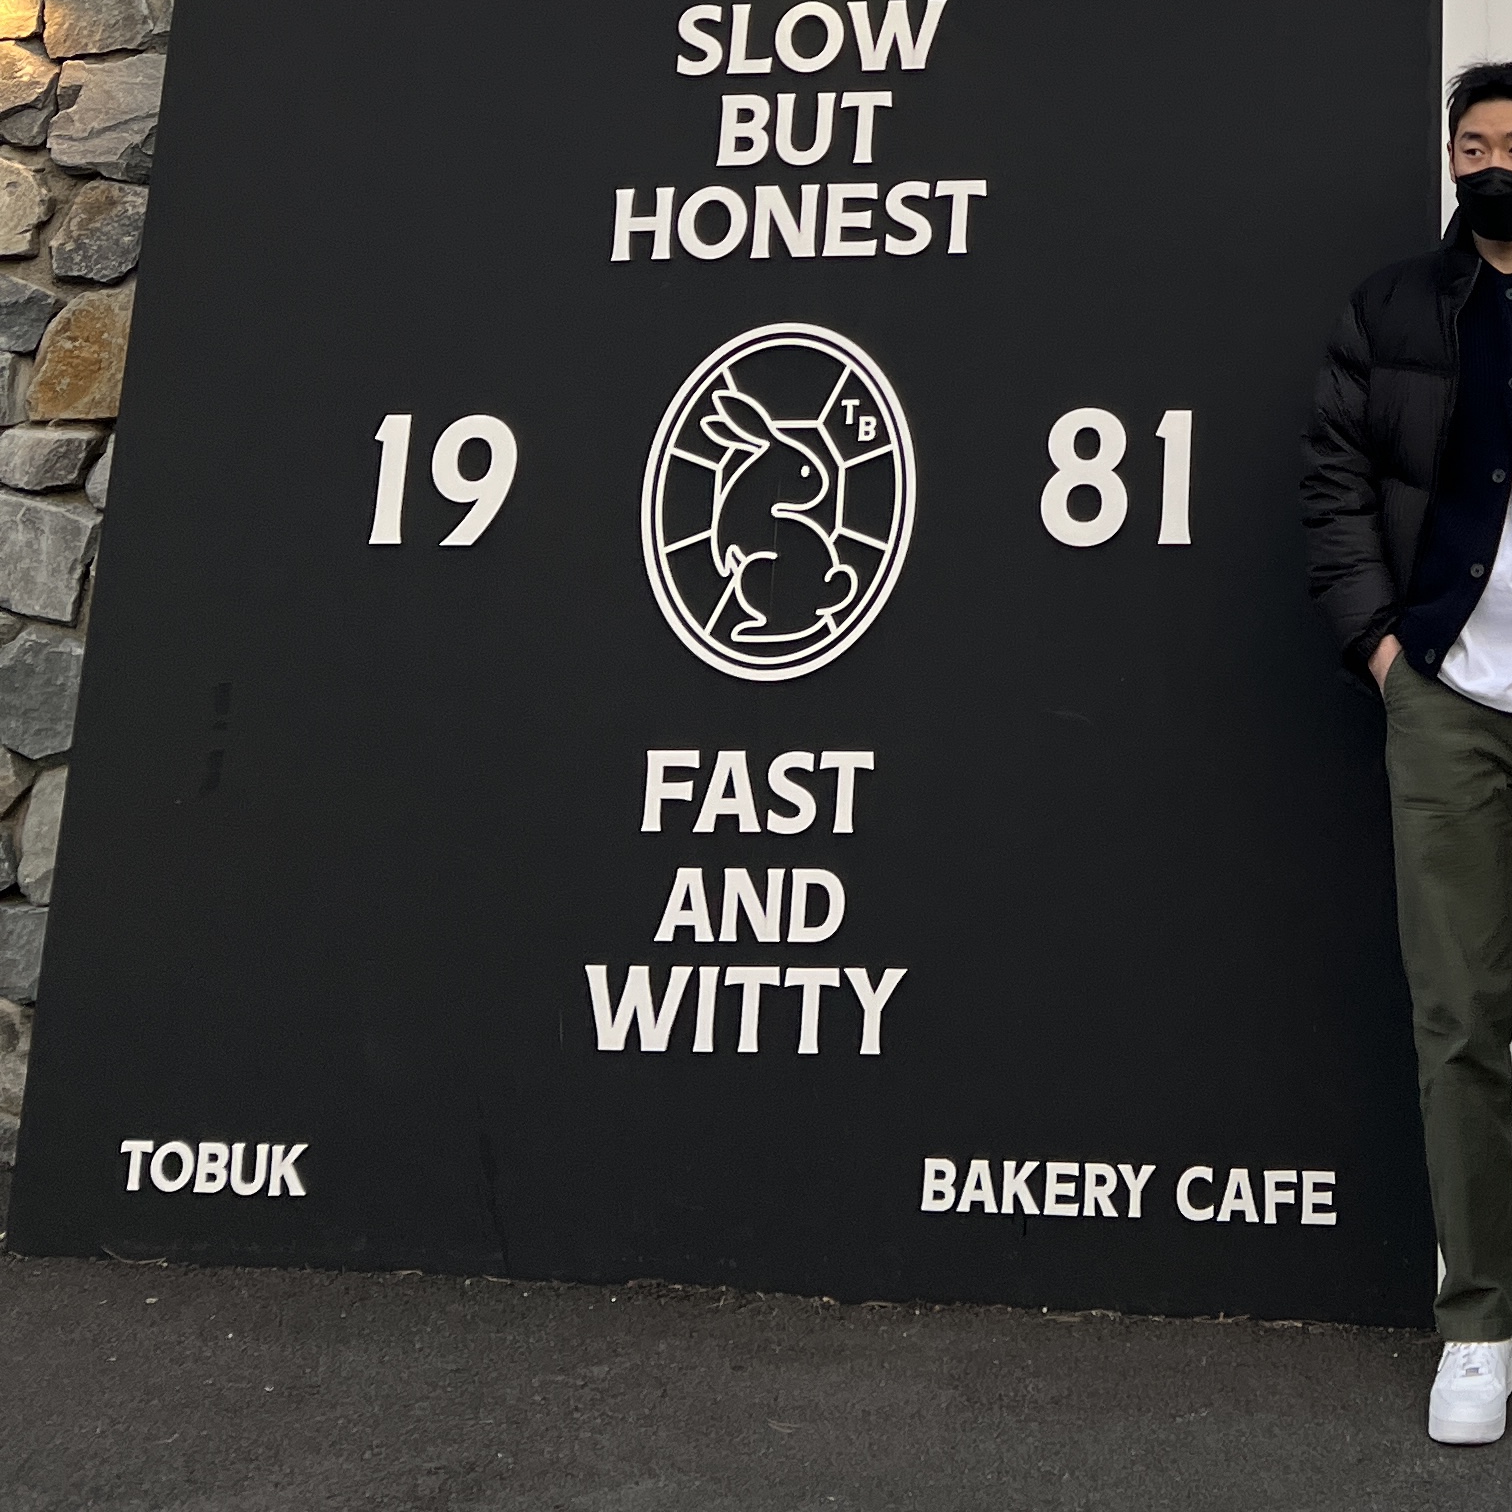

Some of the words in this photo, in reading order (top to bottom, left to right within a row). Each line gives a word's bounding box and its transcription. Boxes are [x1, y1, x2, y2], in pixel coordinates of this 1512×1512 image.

[715, 90, 893, 167] BUT
[610, 179, 988, 262] HONEST
[368, 414, 518, 546] 19
[1040, 407, 1193, 547] 81
[640, 749, 875, 835] FAST
[653, 867, 846, 943] AND
[584, 964, 908, 1055] WITTY
[120, 1139, 309, 1197] TOBUK
[920, 1157, 1157, 1218] BAKERY
[1176, 1165, 1337, 1226] CAFE
